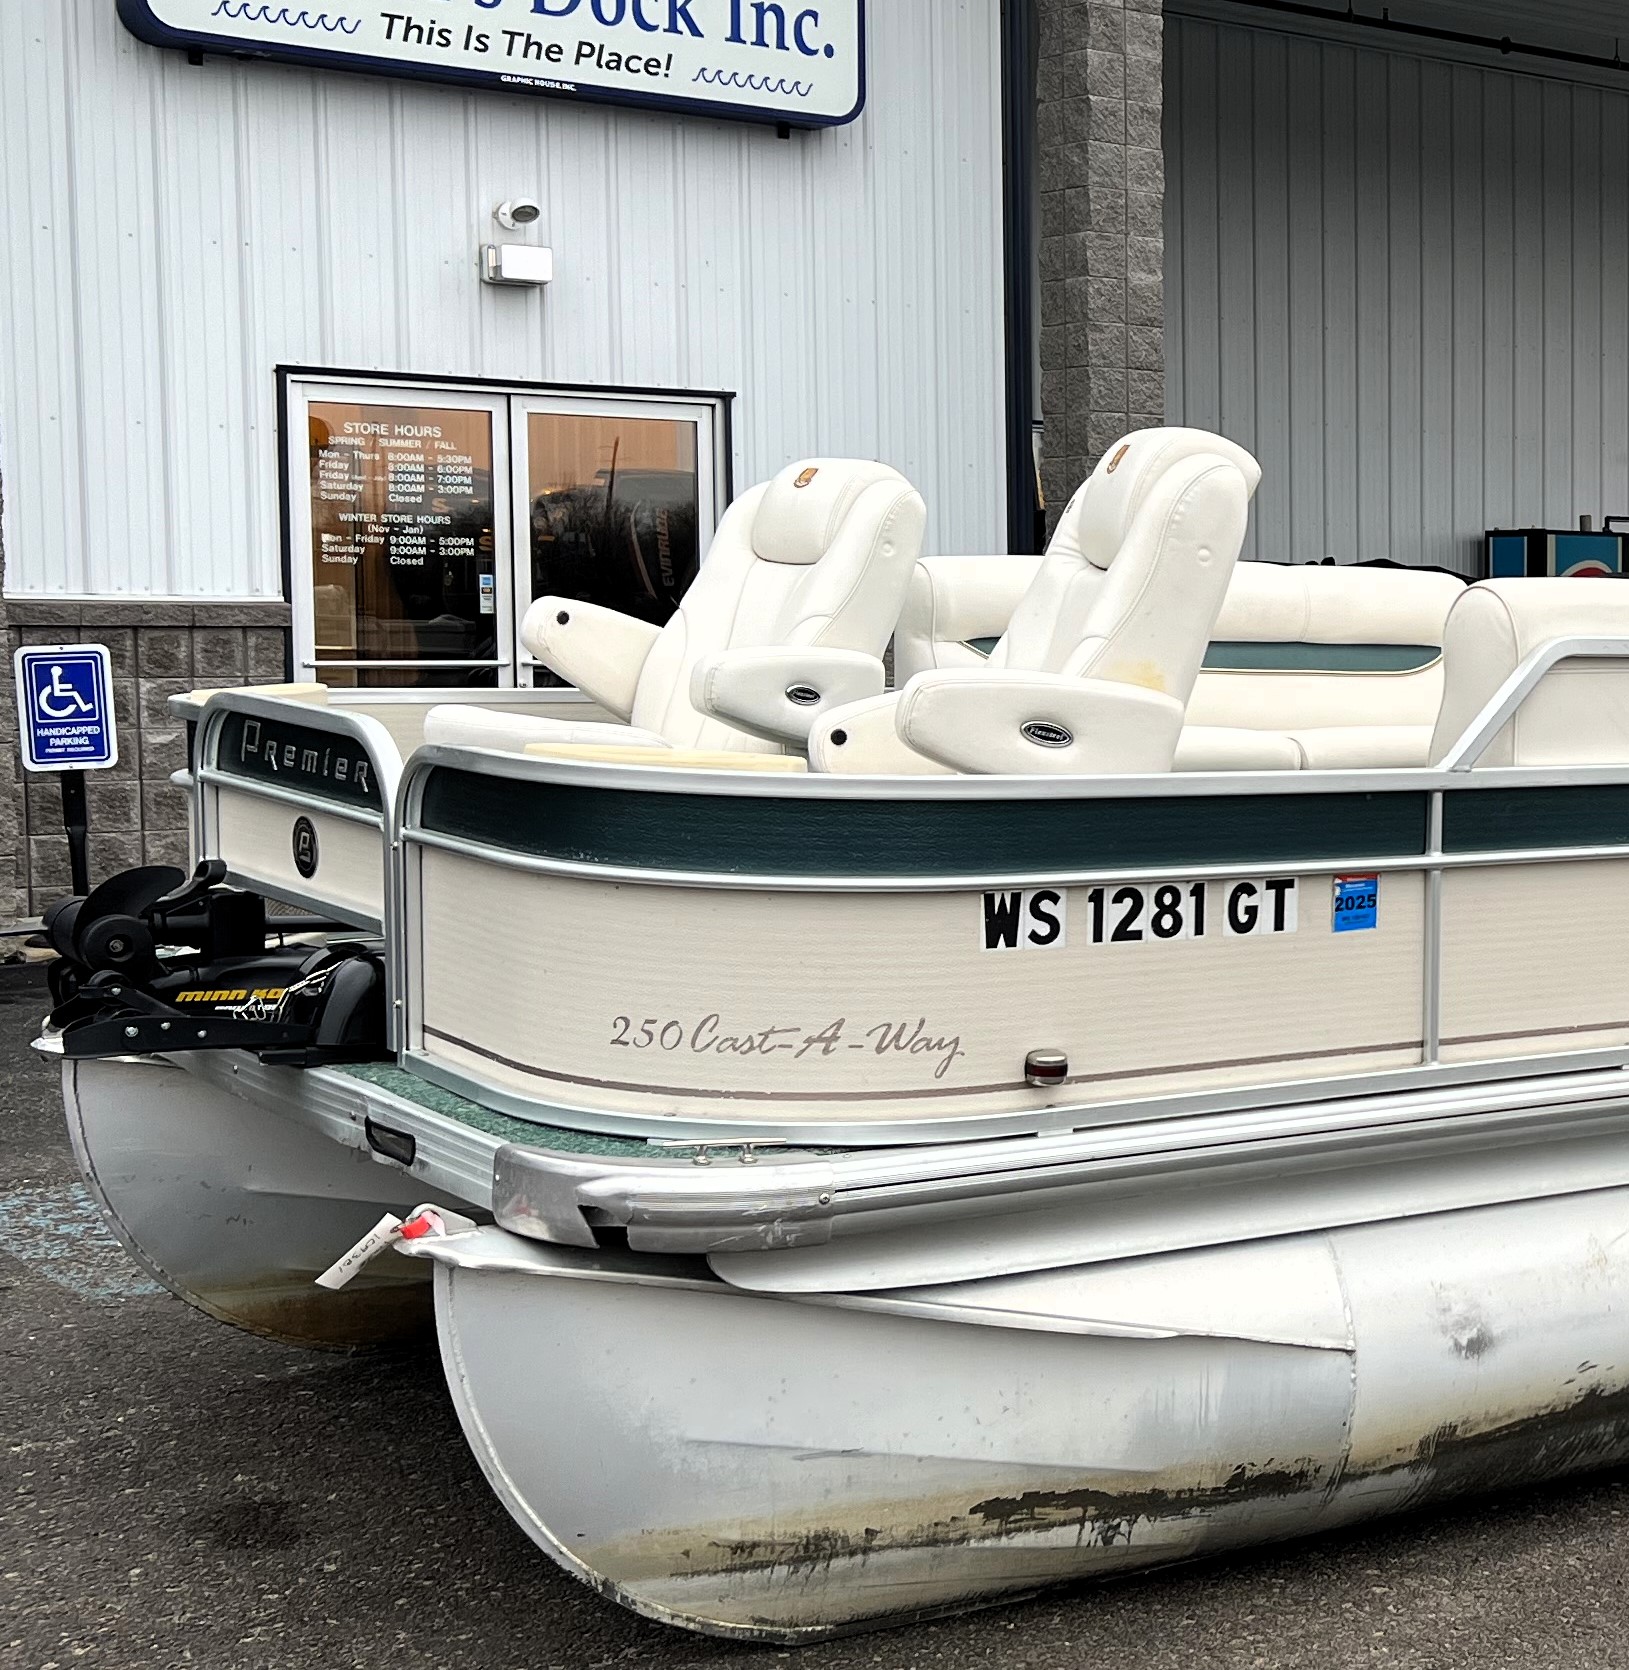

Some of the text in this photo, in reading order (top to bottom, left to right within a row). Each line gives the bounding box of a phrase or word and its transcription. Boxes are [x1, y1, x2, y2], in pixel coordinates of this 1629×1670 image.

[530, 0, 834, 58] ock Inc.
[380, 12, 673, 77] This Is The Place!
[500, 74, 534, 86] GRAPHIC
[343, 422, 442, 438] STORE HOURS
[328, 436, 366, 446] SPRING
[378, 438, 422, 449] SUMMER
[434, 441, 457, 450] FALL
[319, 449, 340, 459] Mon
[353, 450, 380, 460] Thurs
[437, 454, 472, 464] 5:30PM
[319, 459, 349, 471] Friday
[319, 470, 349, 481] Friday
[437, 475, 472, 485] 7:00PM
[320, 480, 364, 492] Saturday
[437, 485, 473, 495] 3:00PM
[320, 491, 422, 503] Sunday Closed
[339, 513, 451, 525] WINTER STORE HOURS
[368, 524, 390, 533] (Nov
[402, 525, 424, 535] Jan)
[355, 534, 385, 545] Friday
[389, 535, 426, 545] 9:00AM
[438, 536, 474, 546] 5:00PM
[321, 544, 366, 555] Saturday
[389, 545, 426, 555] 9:00AM
[438, 547, 474, 556] 3:00PM
[321, 554, 424, 565] Sunday Closed
[37, 726, 100, 736] HANDICAPPED
[49, 736, 90, 747] PARKING
[1335, 894, 1376, 912] 2025
[984, 879, 1295, 949] WS 1281 GT
[610, 1016, 683, 1050] 250
